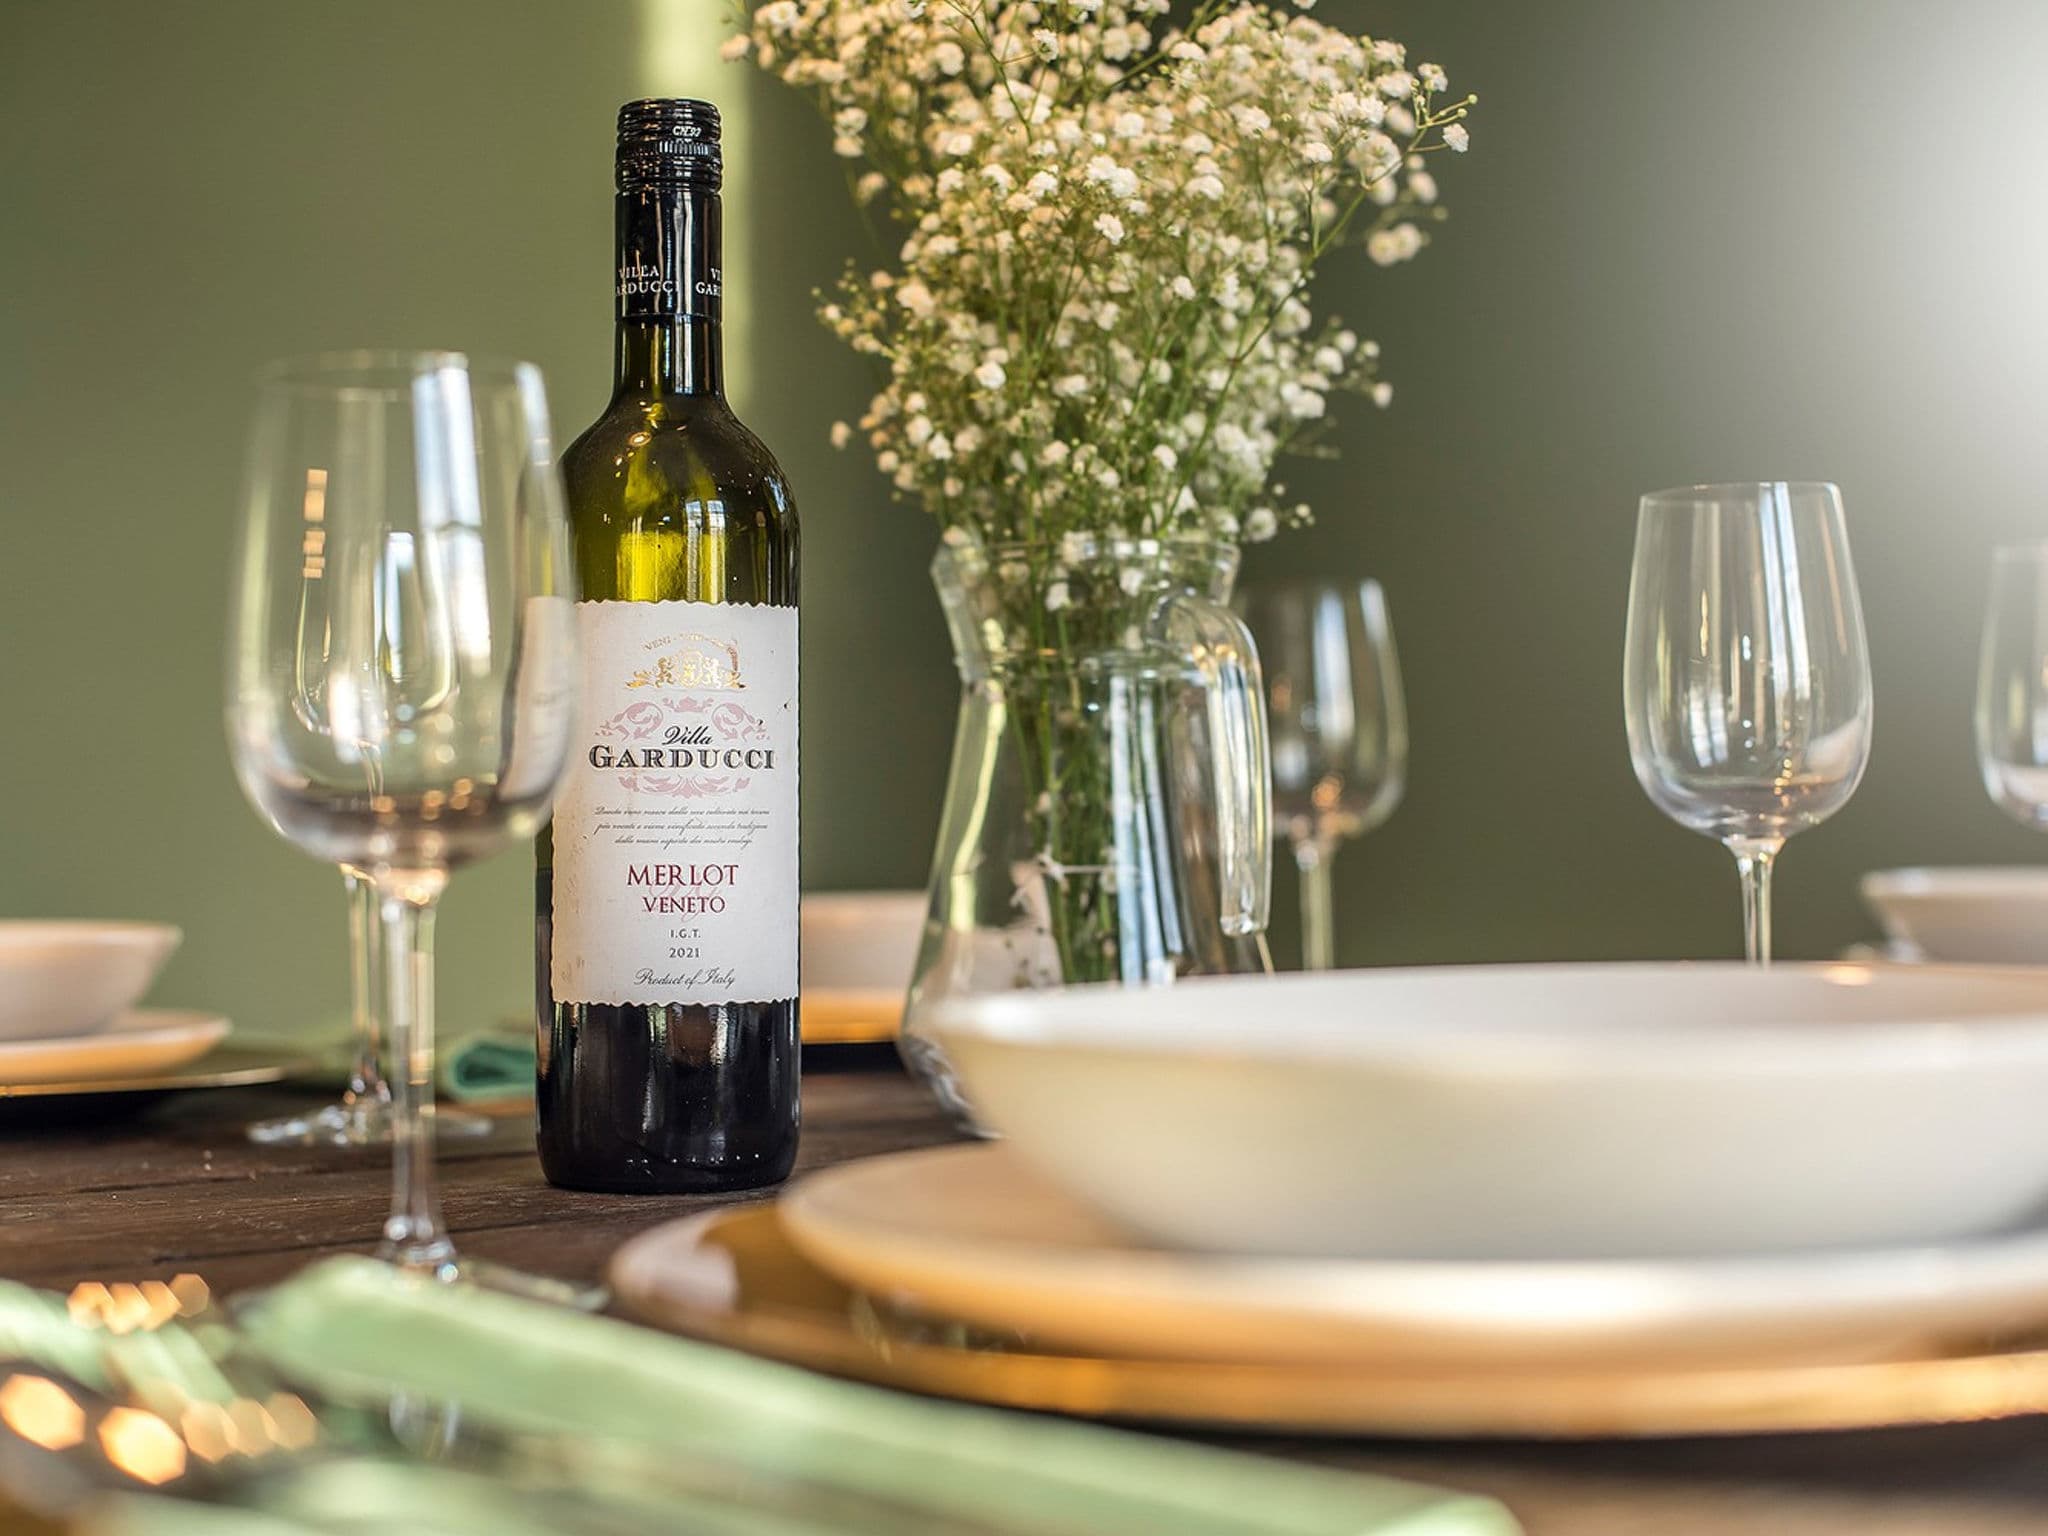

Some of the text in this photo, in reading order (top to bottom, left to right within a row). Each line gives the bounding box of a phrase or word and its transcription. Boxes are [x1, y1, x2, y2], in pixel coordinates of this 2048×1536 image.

[661, 724, 714, 746] Villa
[588, 744, 776, 770] GARDUCCI
[627, 863, 740, 887] MERLOT
[642, 896, 727, 914] VENETO
[669, 928, 702, 940] I.G.T.
[668, 947, 701, 959] 2021
[633, 967, 736, 990] Product of Italy
